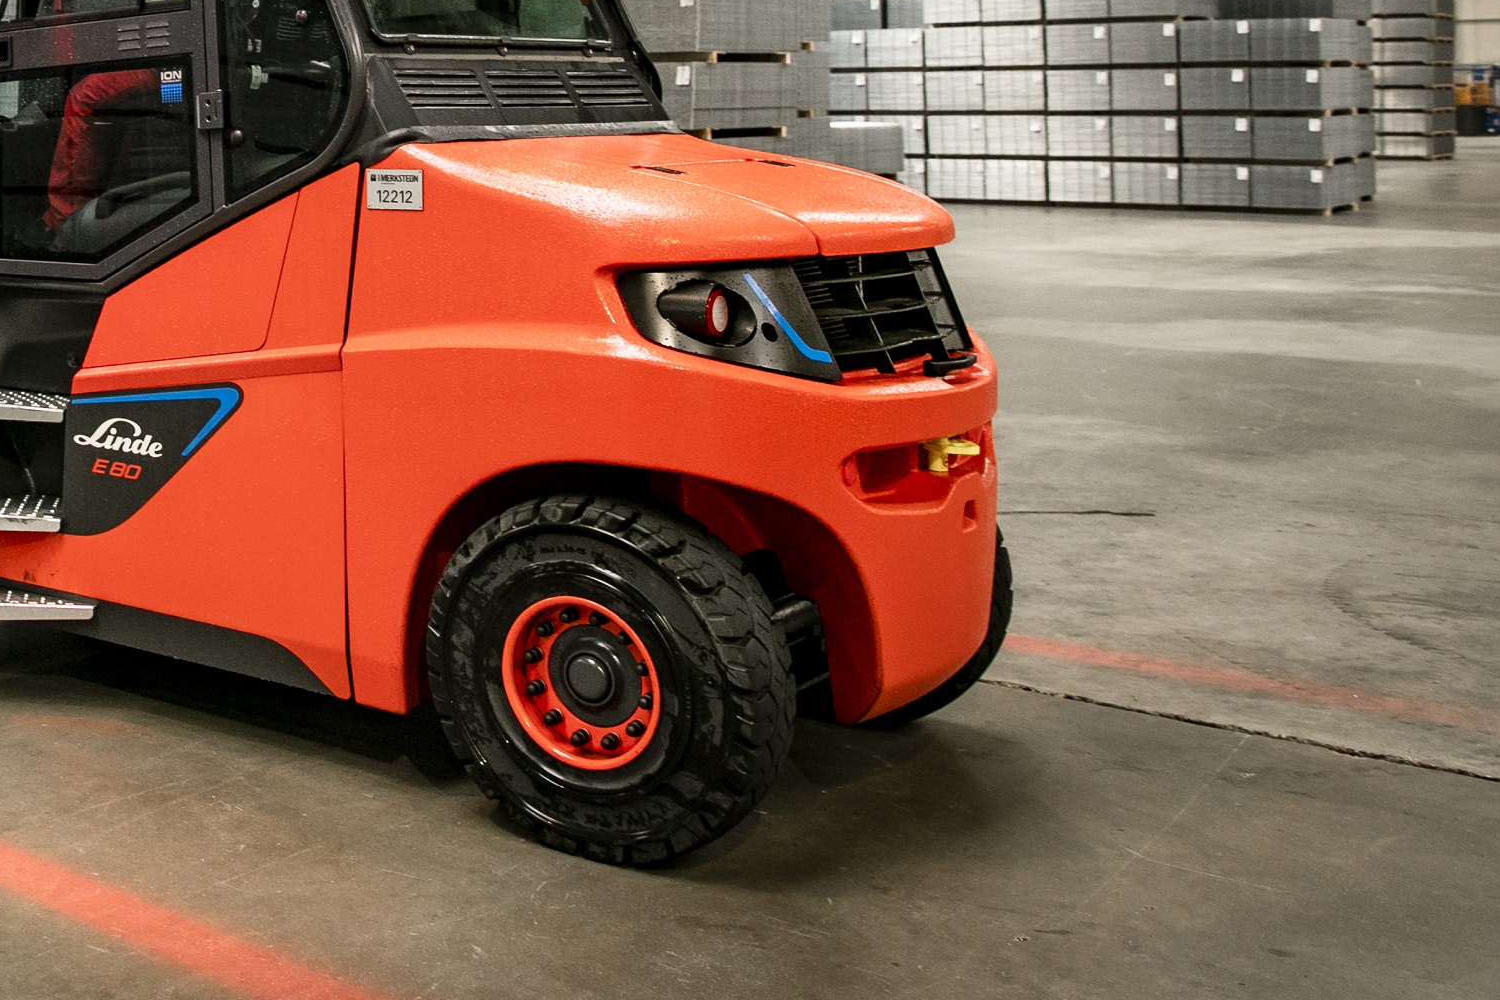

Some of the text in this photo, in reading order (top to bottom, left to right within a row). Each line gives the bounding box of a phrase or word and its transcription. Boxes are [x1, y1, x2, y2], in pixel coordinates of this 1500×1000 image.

[160, 70, 182, 81] ION
[376, 189, 413, 204] 12212
[73, 417, 163, 458] Linde
[91, 458, 142, 481] E 80
